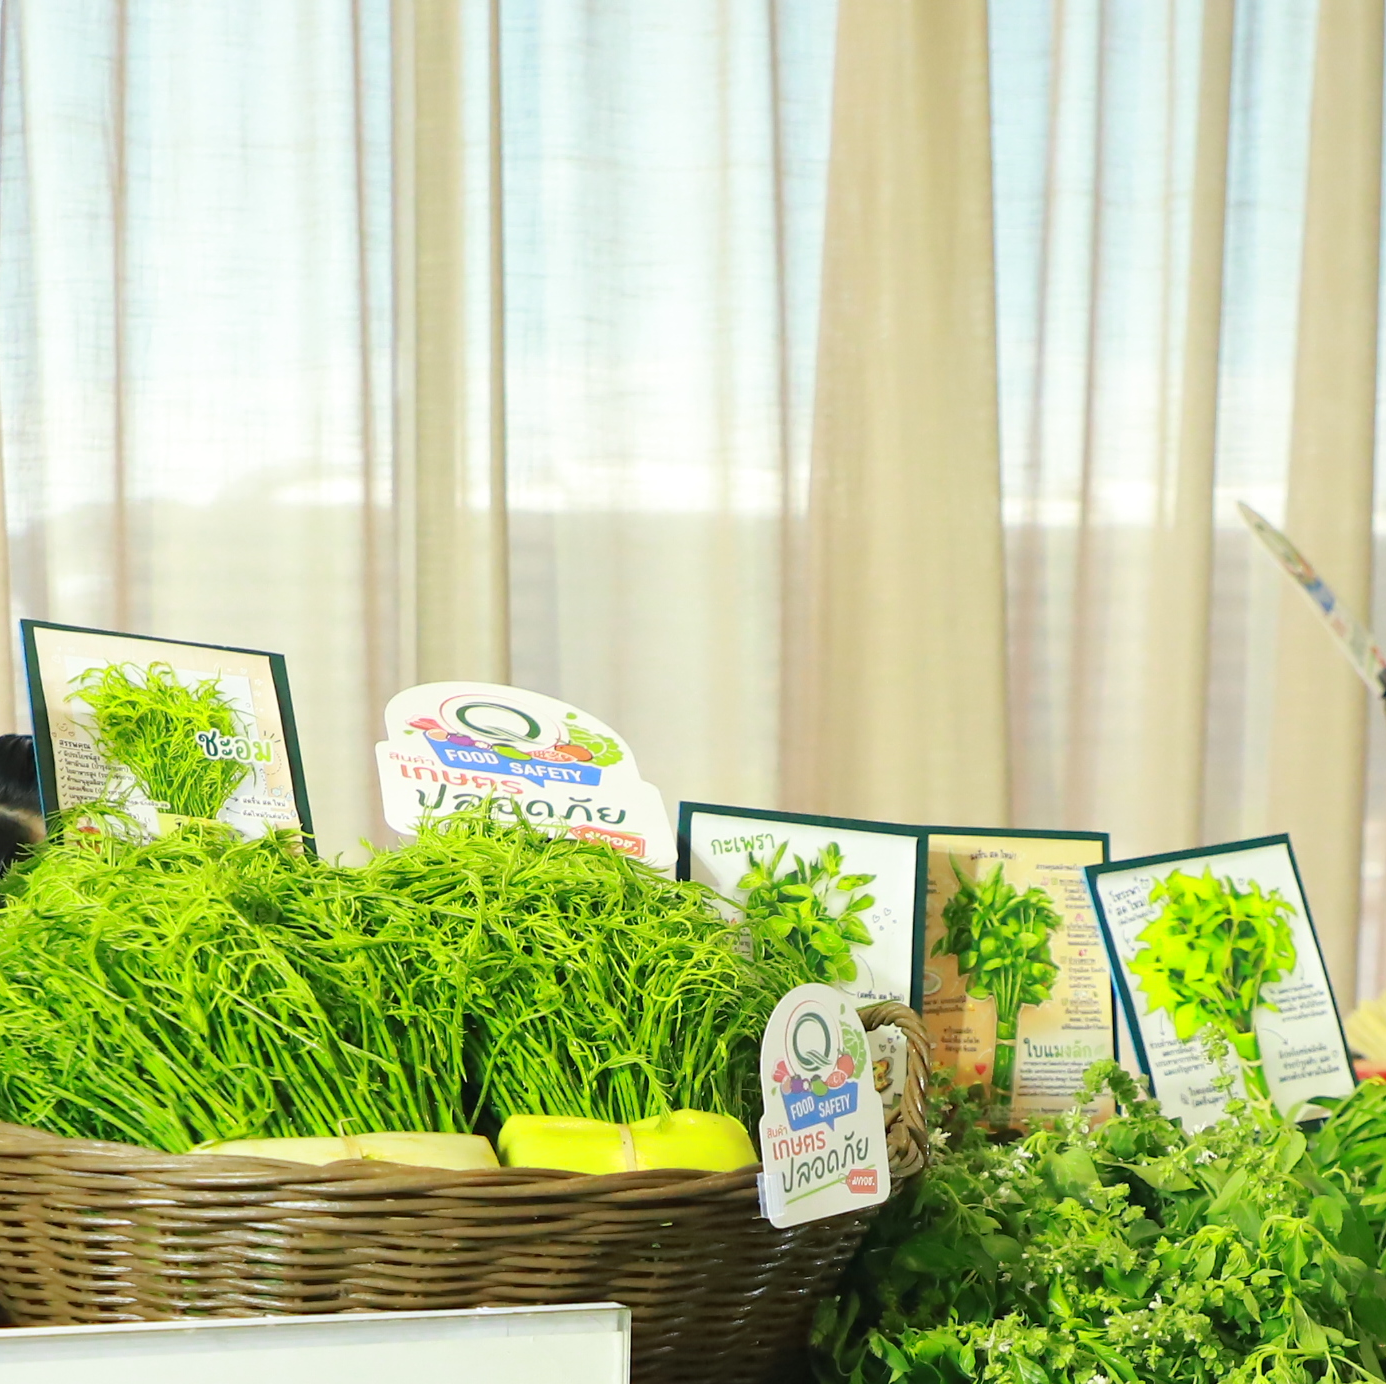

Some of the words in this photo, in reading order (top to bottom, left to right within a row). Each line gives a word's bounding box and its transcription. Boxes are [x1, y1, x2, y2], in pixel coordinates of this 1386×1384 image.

[198, 731, 271, 763] ชะอม
[389, 751, 435, 767] สินค้า
[401, 763, 523, 795] เกษตร
[445, 749, 499, 765] FOOD
[510, 761, 582, 782] SAFETY
[710, 833, 775, 856] กะเพรา
[1024, 1038, 1092, 1058] ใบแมงลัก
[790, 1096, 815, 1121] FOOD
[818, 1093, 850, 1118] SAFETY
[767, 1124, 788, 1139] สินค้า
[773, 1130, 826, 1161] เกษตร
[782, 1131, 869, 1193] ปลอดภัย
